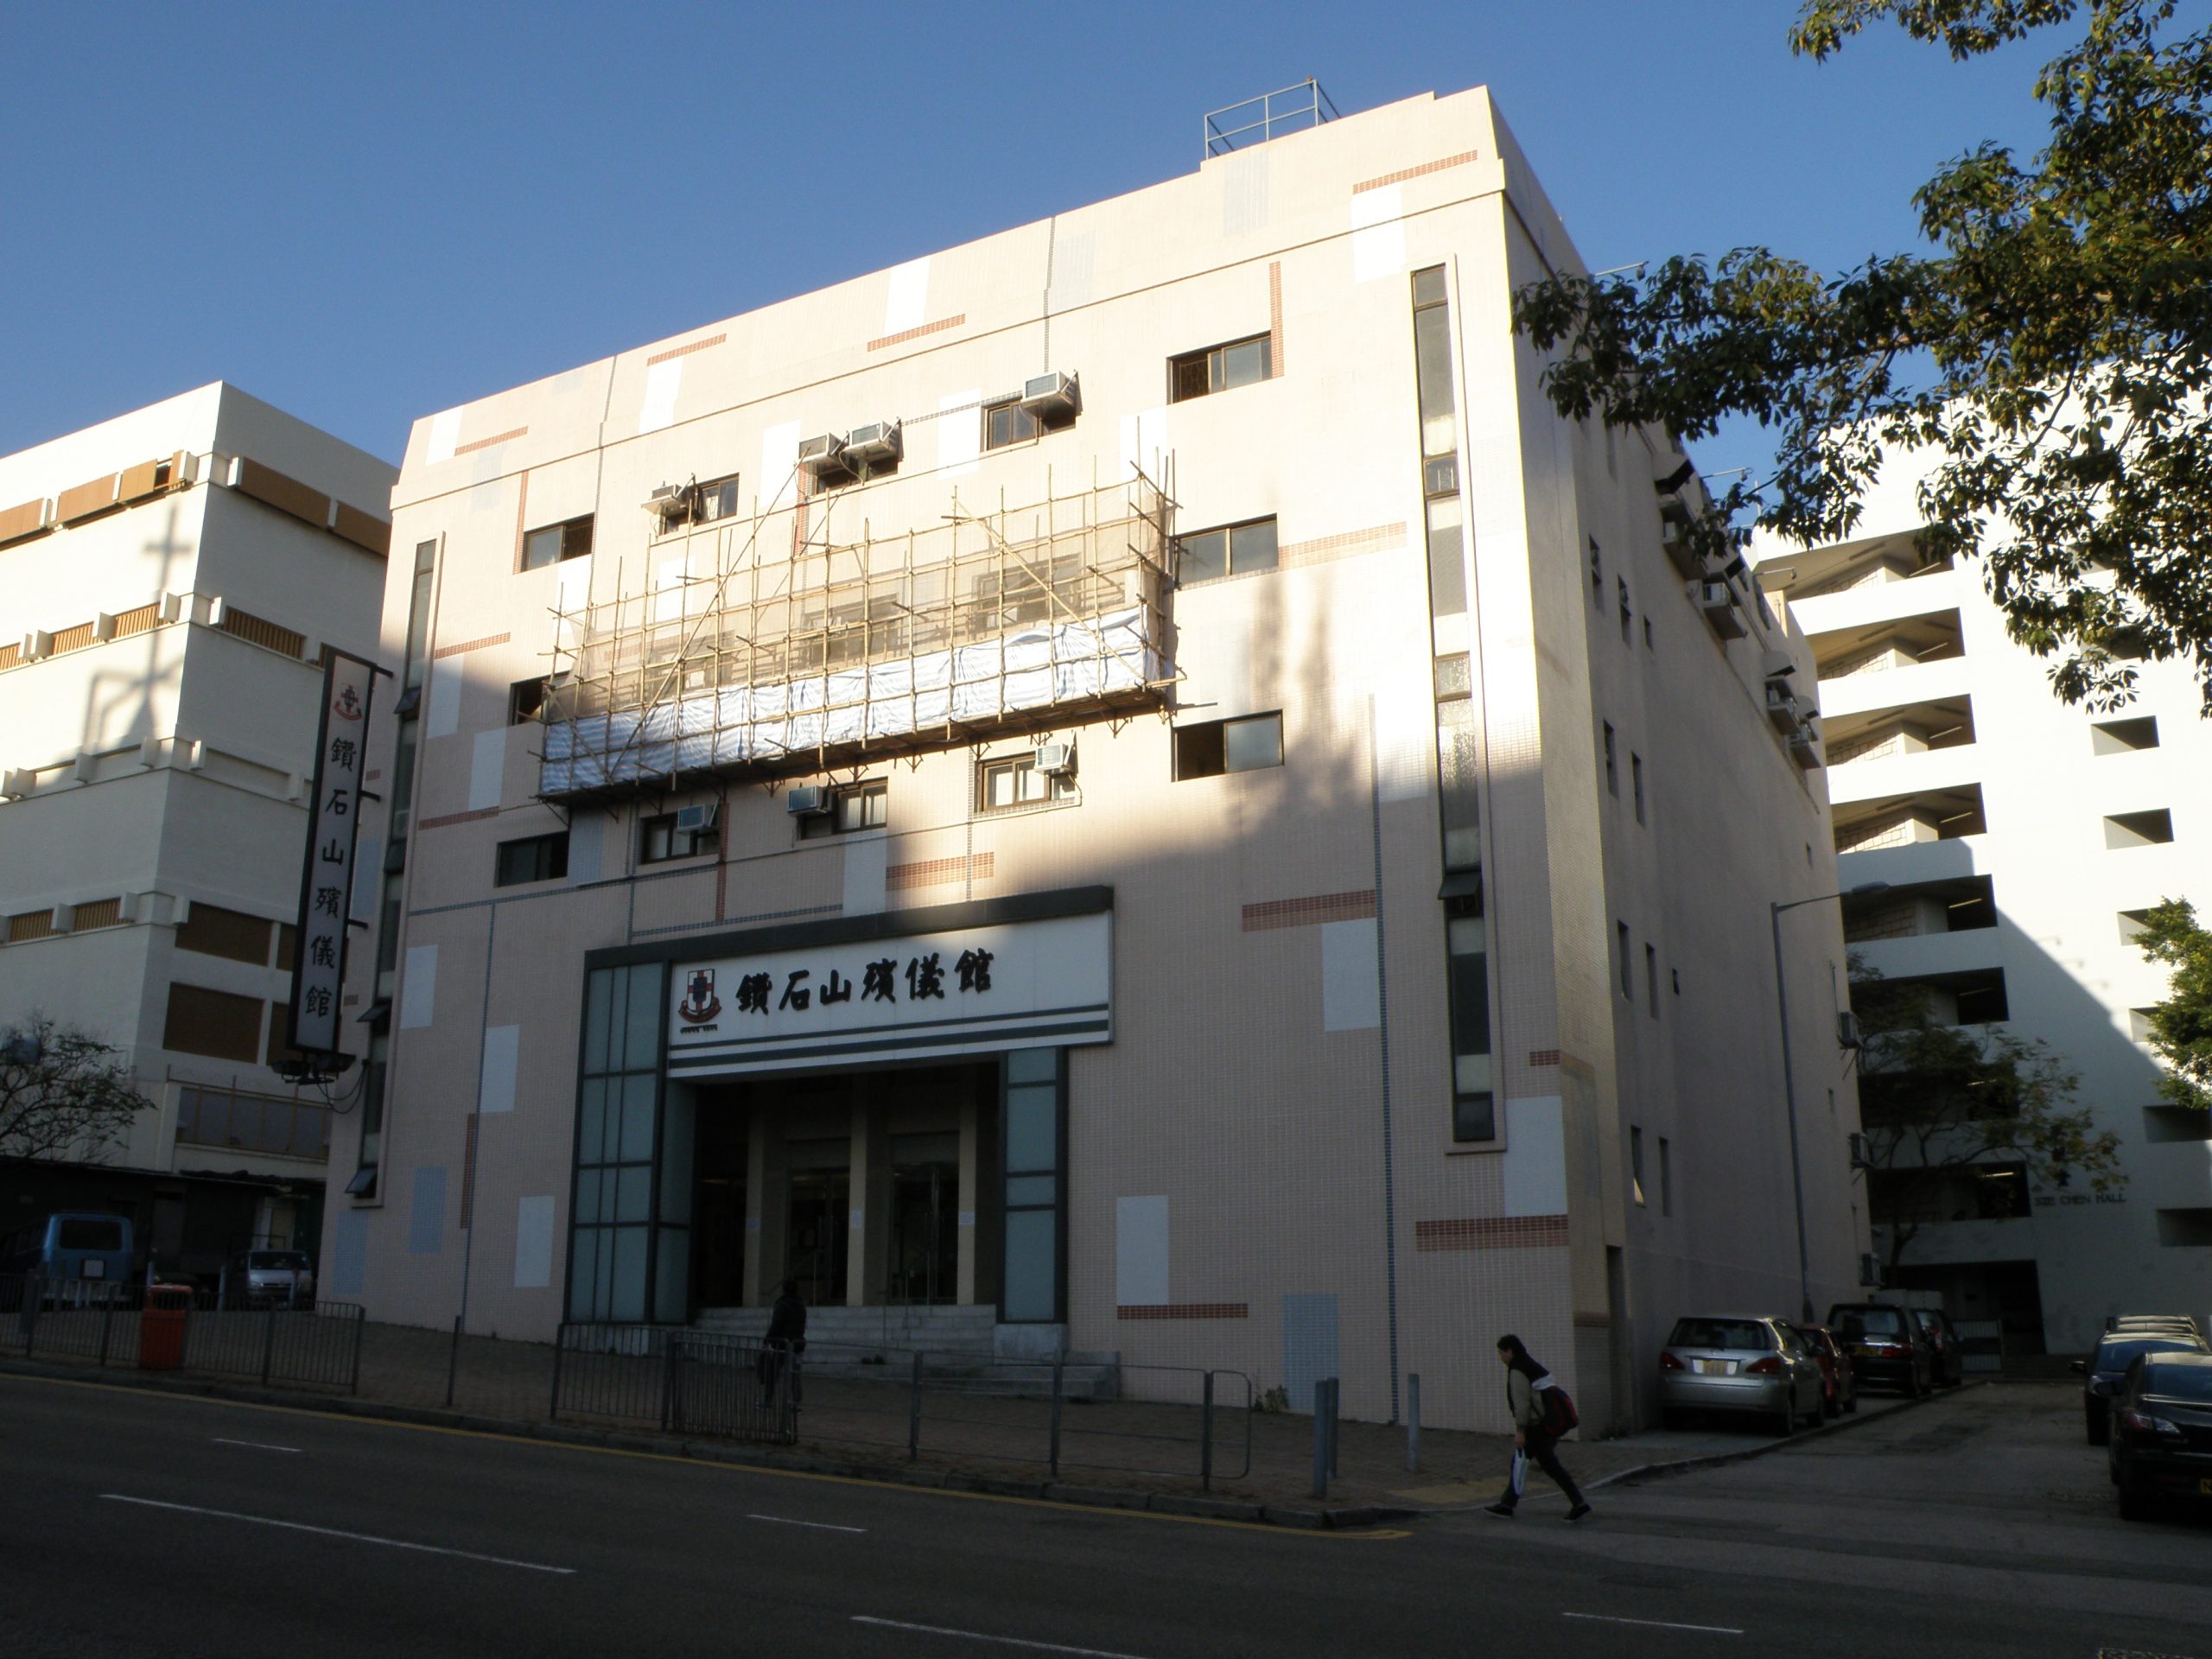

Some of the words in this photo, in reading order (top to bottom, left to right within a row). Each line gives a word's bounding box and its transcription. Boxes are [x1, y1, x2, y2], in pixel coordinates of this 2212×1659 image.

[305, 736, 355, 1019] 鑽石山殯儀館
[735, 948, 994, 1015] 鑽石山殯儀館
[2096, 1193, 2126, 1204] HALL
